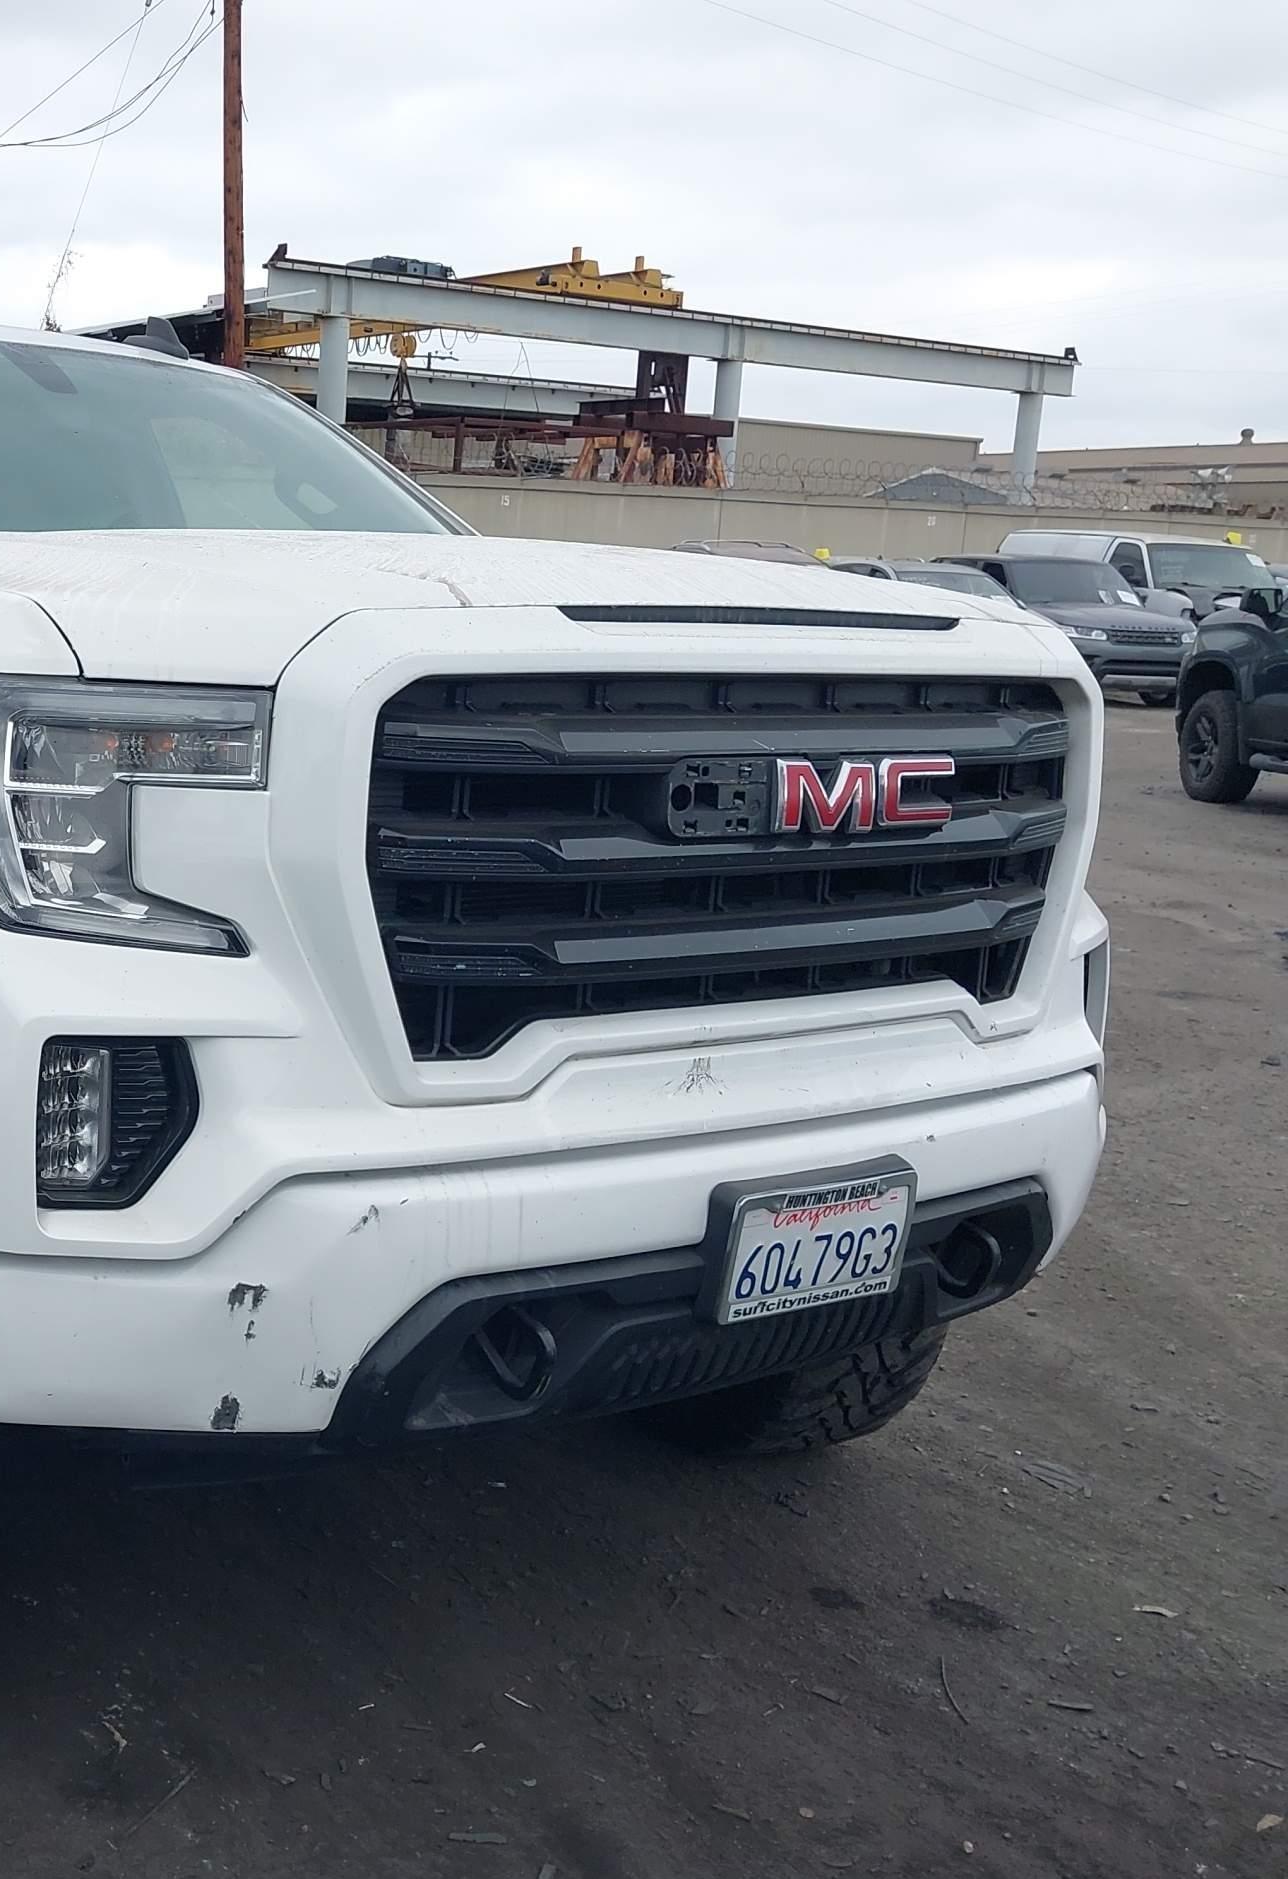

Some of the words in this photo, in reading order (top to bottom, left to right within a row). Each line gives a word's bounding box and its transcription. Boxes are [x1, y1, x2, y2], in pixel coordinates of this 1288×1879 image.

[785, 1186, 849, 1209] HUNTINGTON
[849, 1181, 878, 1201] BEACH
[773, 1199, 882, 1232] California
[734, 1222, 899, 1300] 60479G3
[732, 1279, 888, 1319] surfcitynissan.com
